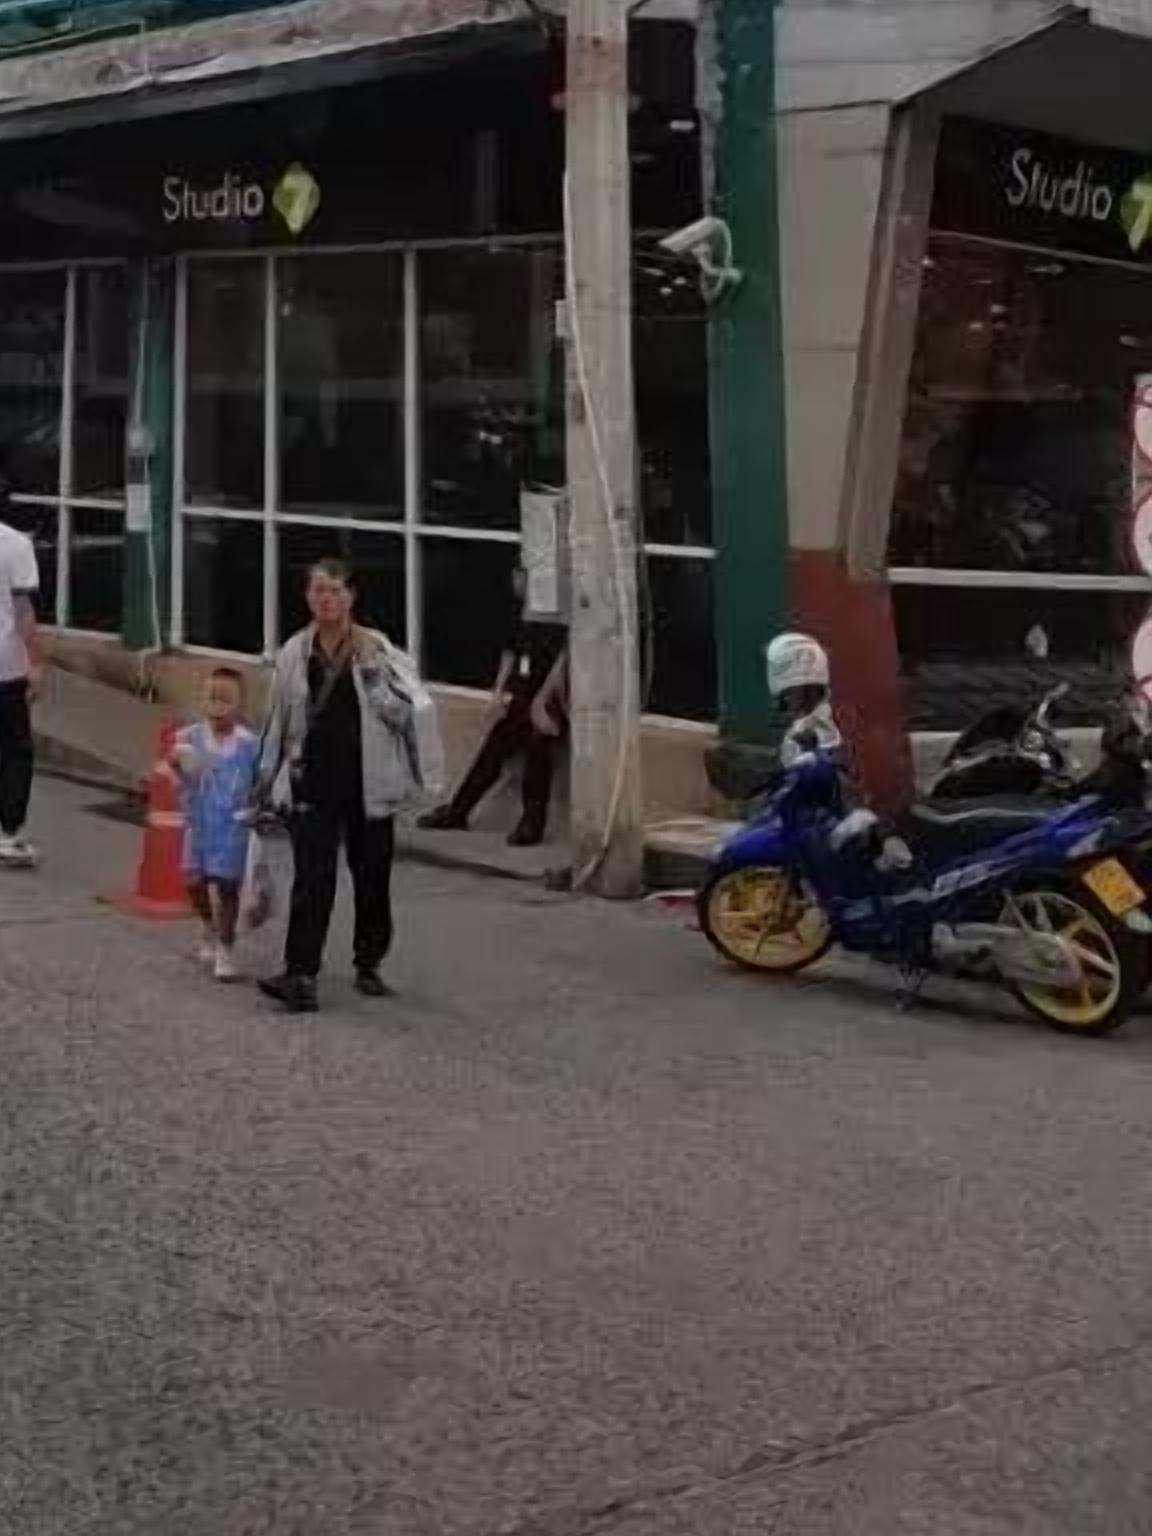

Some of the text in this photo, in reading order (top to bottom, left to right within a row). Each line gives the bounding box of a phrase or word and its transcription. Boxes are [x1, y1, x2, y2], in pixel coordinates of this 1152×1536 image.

[163, 166, 317, 233] Studio 7
[1004, 148, 1112, 220] Studio
